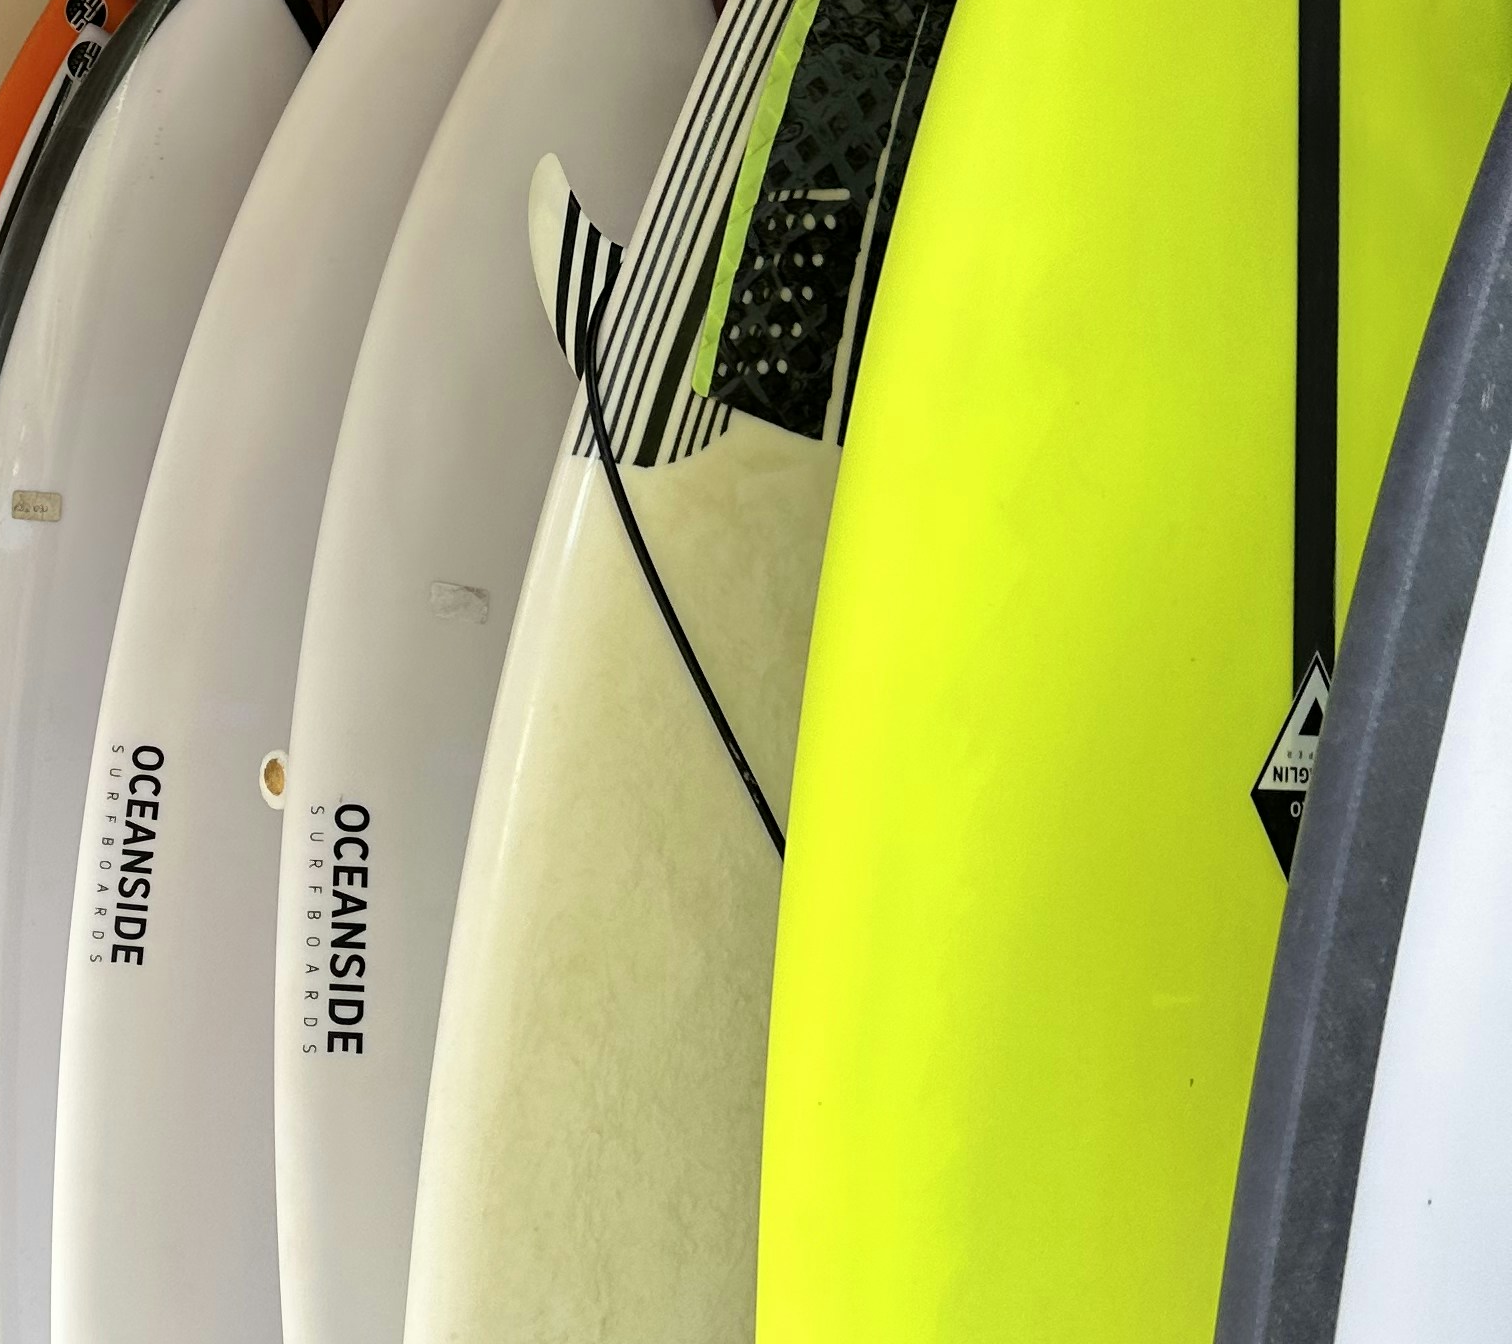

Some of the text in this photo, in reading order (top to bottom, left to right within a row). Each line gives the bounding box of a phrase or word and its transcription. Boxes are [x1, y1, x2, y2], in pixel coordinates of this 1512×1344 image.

[89, 744, 125, 963] SURFBOARDS
[110, 744, 165, 966] OCEANSIDE
[1273, 766, 1313, 784] GLIN
[302, 805, 325, 1054] SURFBOARDS
[326, 803, 371, 1054] OCEANSIDE
